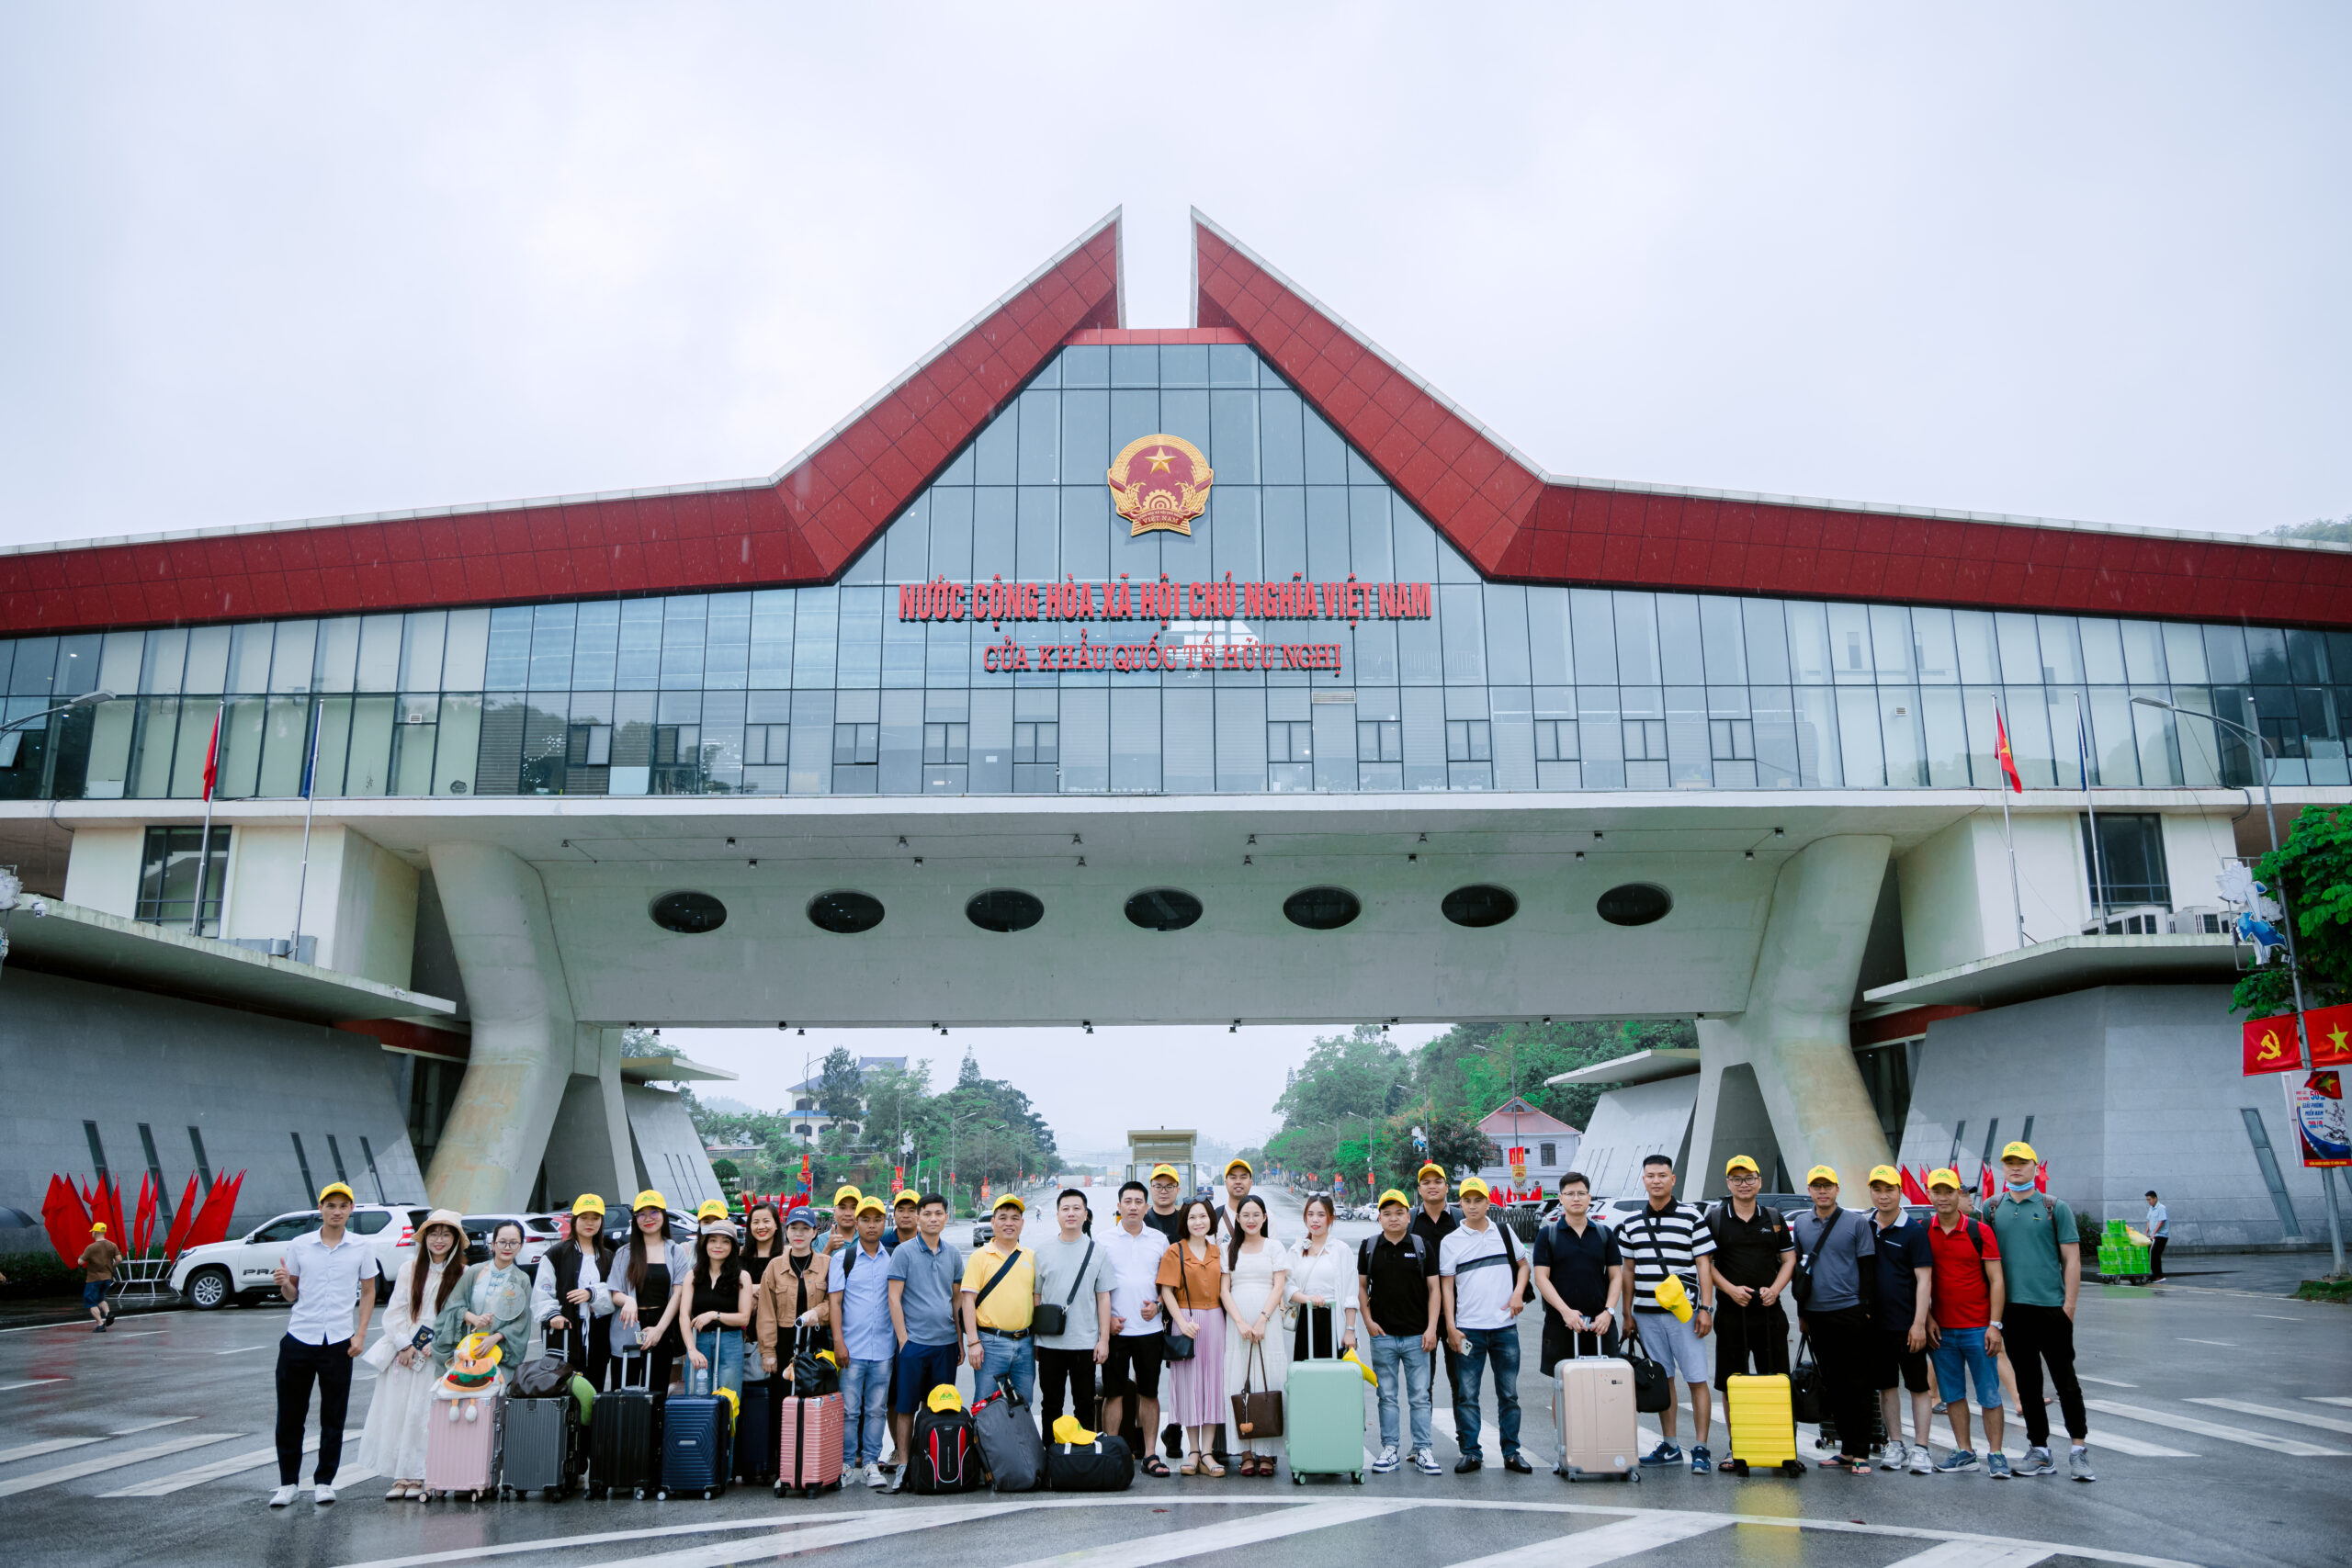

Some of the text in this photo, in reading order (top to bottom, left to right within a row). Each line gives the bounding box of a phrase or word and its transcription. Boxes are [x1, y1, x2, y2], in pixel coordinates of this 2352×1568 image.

[899, 570, 1432, 627] NƯỚC CỘNG HÒA XÃ HỘI CHỦ NGHĨA VIỆT NAM
[983, 627, 1342, 676] CỬA KHẨU QUỐC TẾ HỮU NGHỊ
[2310, 1089, 2320, 1100] 50
